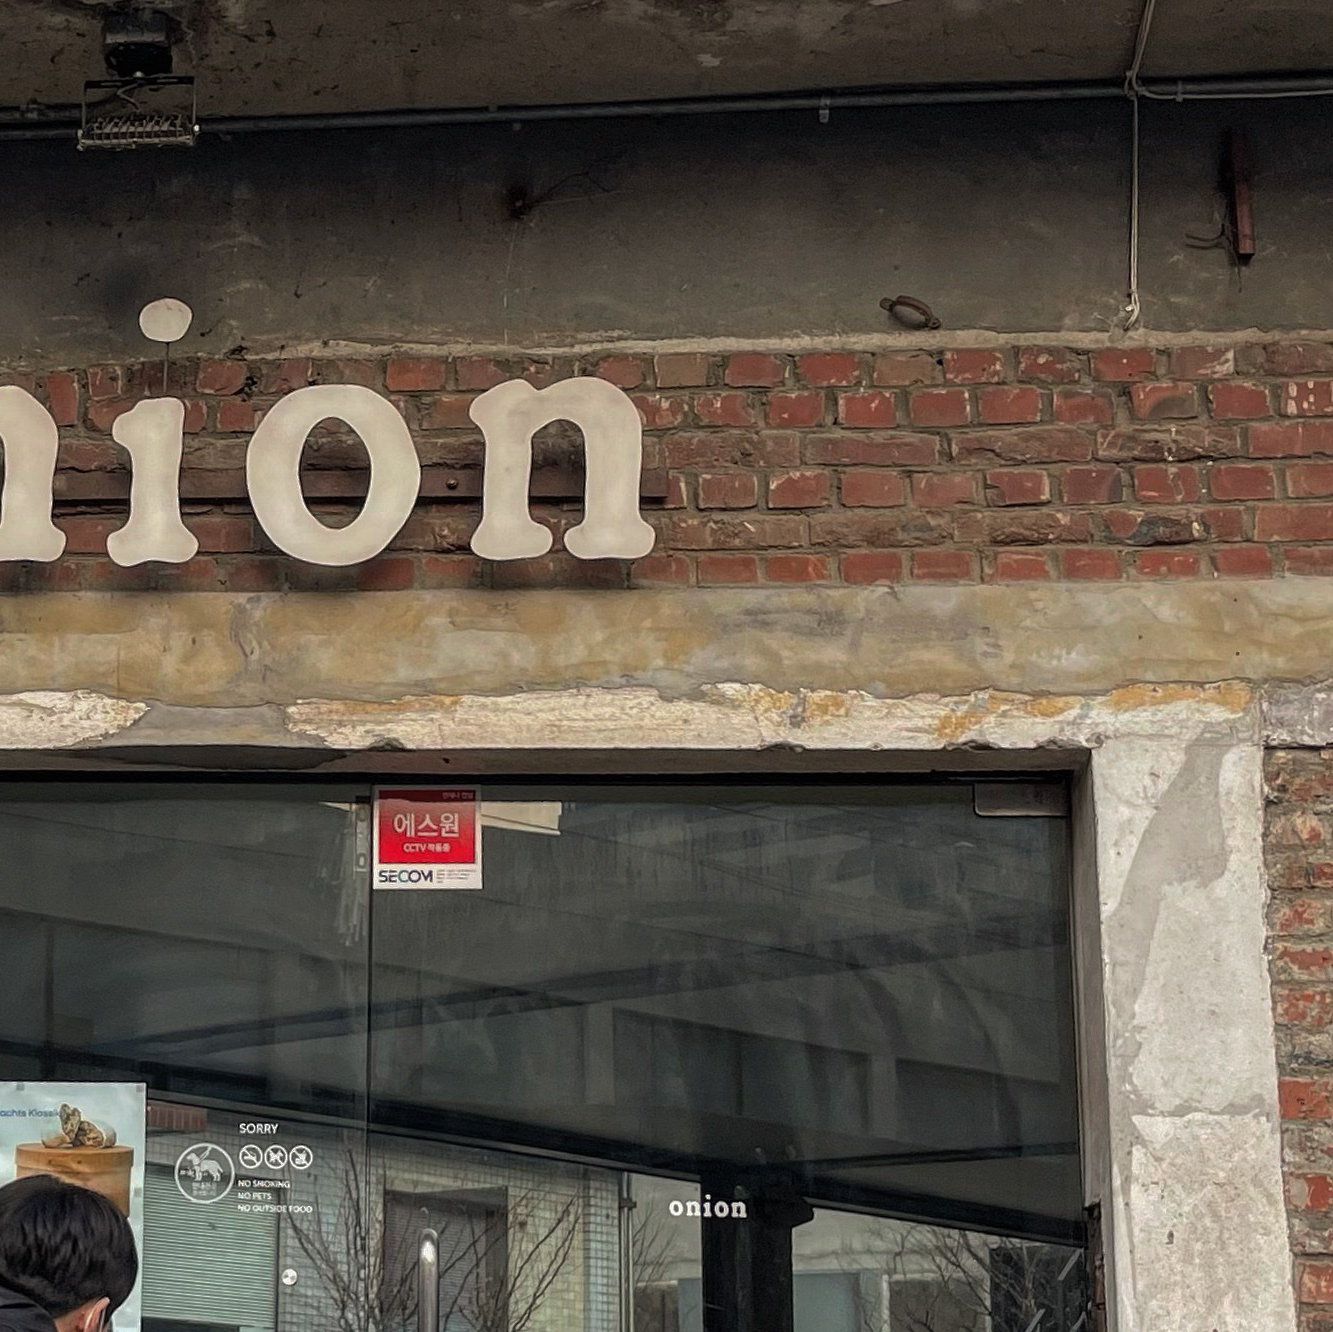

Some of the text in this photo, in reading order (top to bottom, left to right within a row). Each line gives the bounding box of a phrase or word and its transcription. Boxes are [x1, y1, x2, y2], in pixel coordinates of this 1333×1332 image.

[393, 812, 460, 838] 에스원
[403, 842, 426, 853] CCTV
[378, 869, 434, 884] SECOM
[239, 1123, 279, 1134] SORRY
[238, 1180, 290, 1189] NO SMOKING
[253, 1192, 272, 1200] PETS
[238, 1204, 313, 1213] NO OUTSIDE FOOD
[669, 1194, 747, 1218] onion
